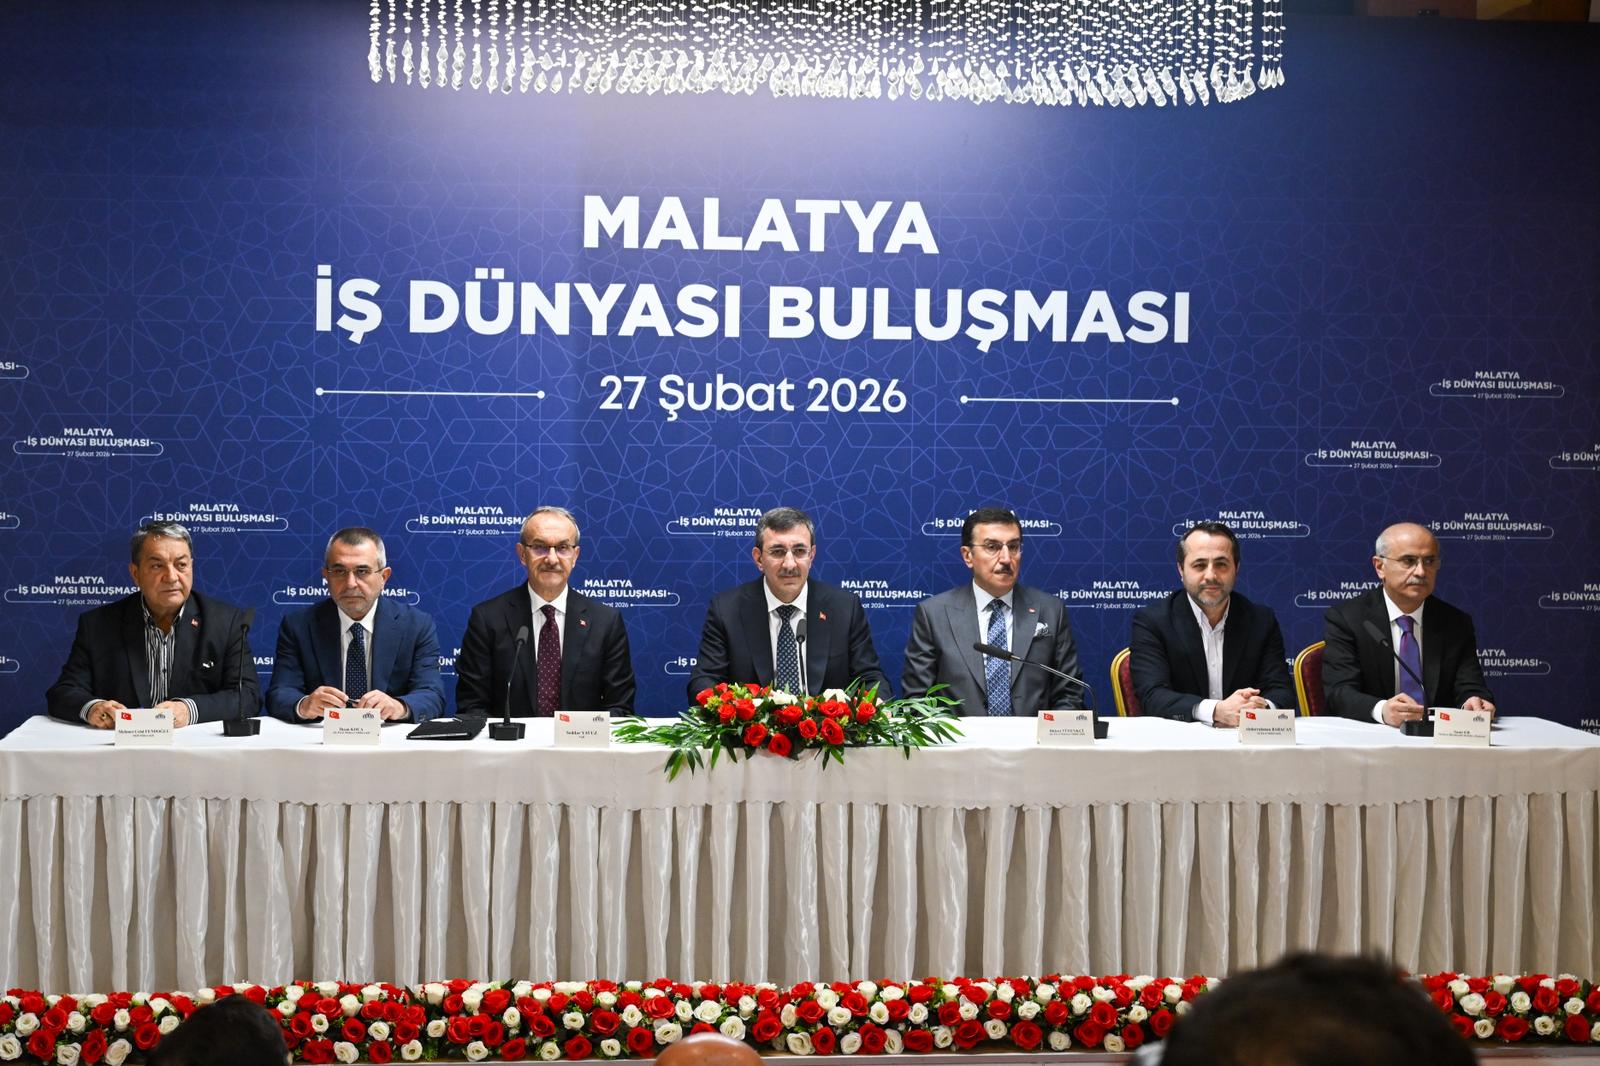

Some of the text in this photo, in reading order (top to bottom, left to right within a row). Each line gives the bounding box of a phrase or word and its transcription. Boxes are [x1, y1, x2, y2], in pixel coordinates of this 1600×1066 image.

[584, 195, 939, 253] MALATYA
[316, 265, 1189, 353] İŞ DÜNYASI BULUŞMASI
[1475, 371, 1520, 379] MALATYA
[1443, 378, 1552, 390] İŞ DÜNYASI BULUŞMASI
[600, 374, 906, 421] 27 Şubat 2026
[64, 428, 113, 436] MALATYA
[28, 436, 149, 447] İŞ DÜNYASI BULUŞMASI
[1352, 441, 1396, 449] MALATYA
[1318, 449, 1428, 459] İŞ DÜNYASI BULUŞMASI
[1573, 450, 1600, 461] DÜNY
[190, 504, 239, 512] MALATYA
[714, 508, 762, 516] MALATYA
[167, 512, 212, 521] DÜNYASI
[215, 514, 274, 523] BULUŞMASI
[420, 514, 429, 525] İŞ
[432, 515, 477, 524] DÜNYASI
[1219, 511, 1264, 519] MALATYA
[680, 516, 689, 527] İŞ
[692, 516, 736, 526] DÜNYASI
[935, 518, 944, 528] İŞ
[1242, 521, 1297, 530] BULUŞMASI
[1432, 521, 1541, 531] İŞ DÜNYASI BULUŞMASI
[55, 576, 104, 584] MALATYA
[1093, 581, 1139, 589] MALATYA
[19, 584, 28, 595] İŞ
[31, 585, 77, 594] DÜNYASI
[1340, 582, 1381, 590] MALATY
[287, 586, 330, 597] İŞ DÜNY
[609, 590, 666, 598] BULUŞMASI
[866, 591, 922, 599] BULUŞMASI
[1060, 590, 1069, 599] İŞ
[1072, 588, 1114, 599] DÜNYASI
[1308, 590, 1317, 600] İŞ
[1563, 590, 1600, 600] DÜNYAS
[678, 657, 687, 667] İŞ
[1484, 659, 1538, 667] BULUŞMASI
